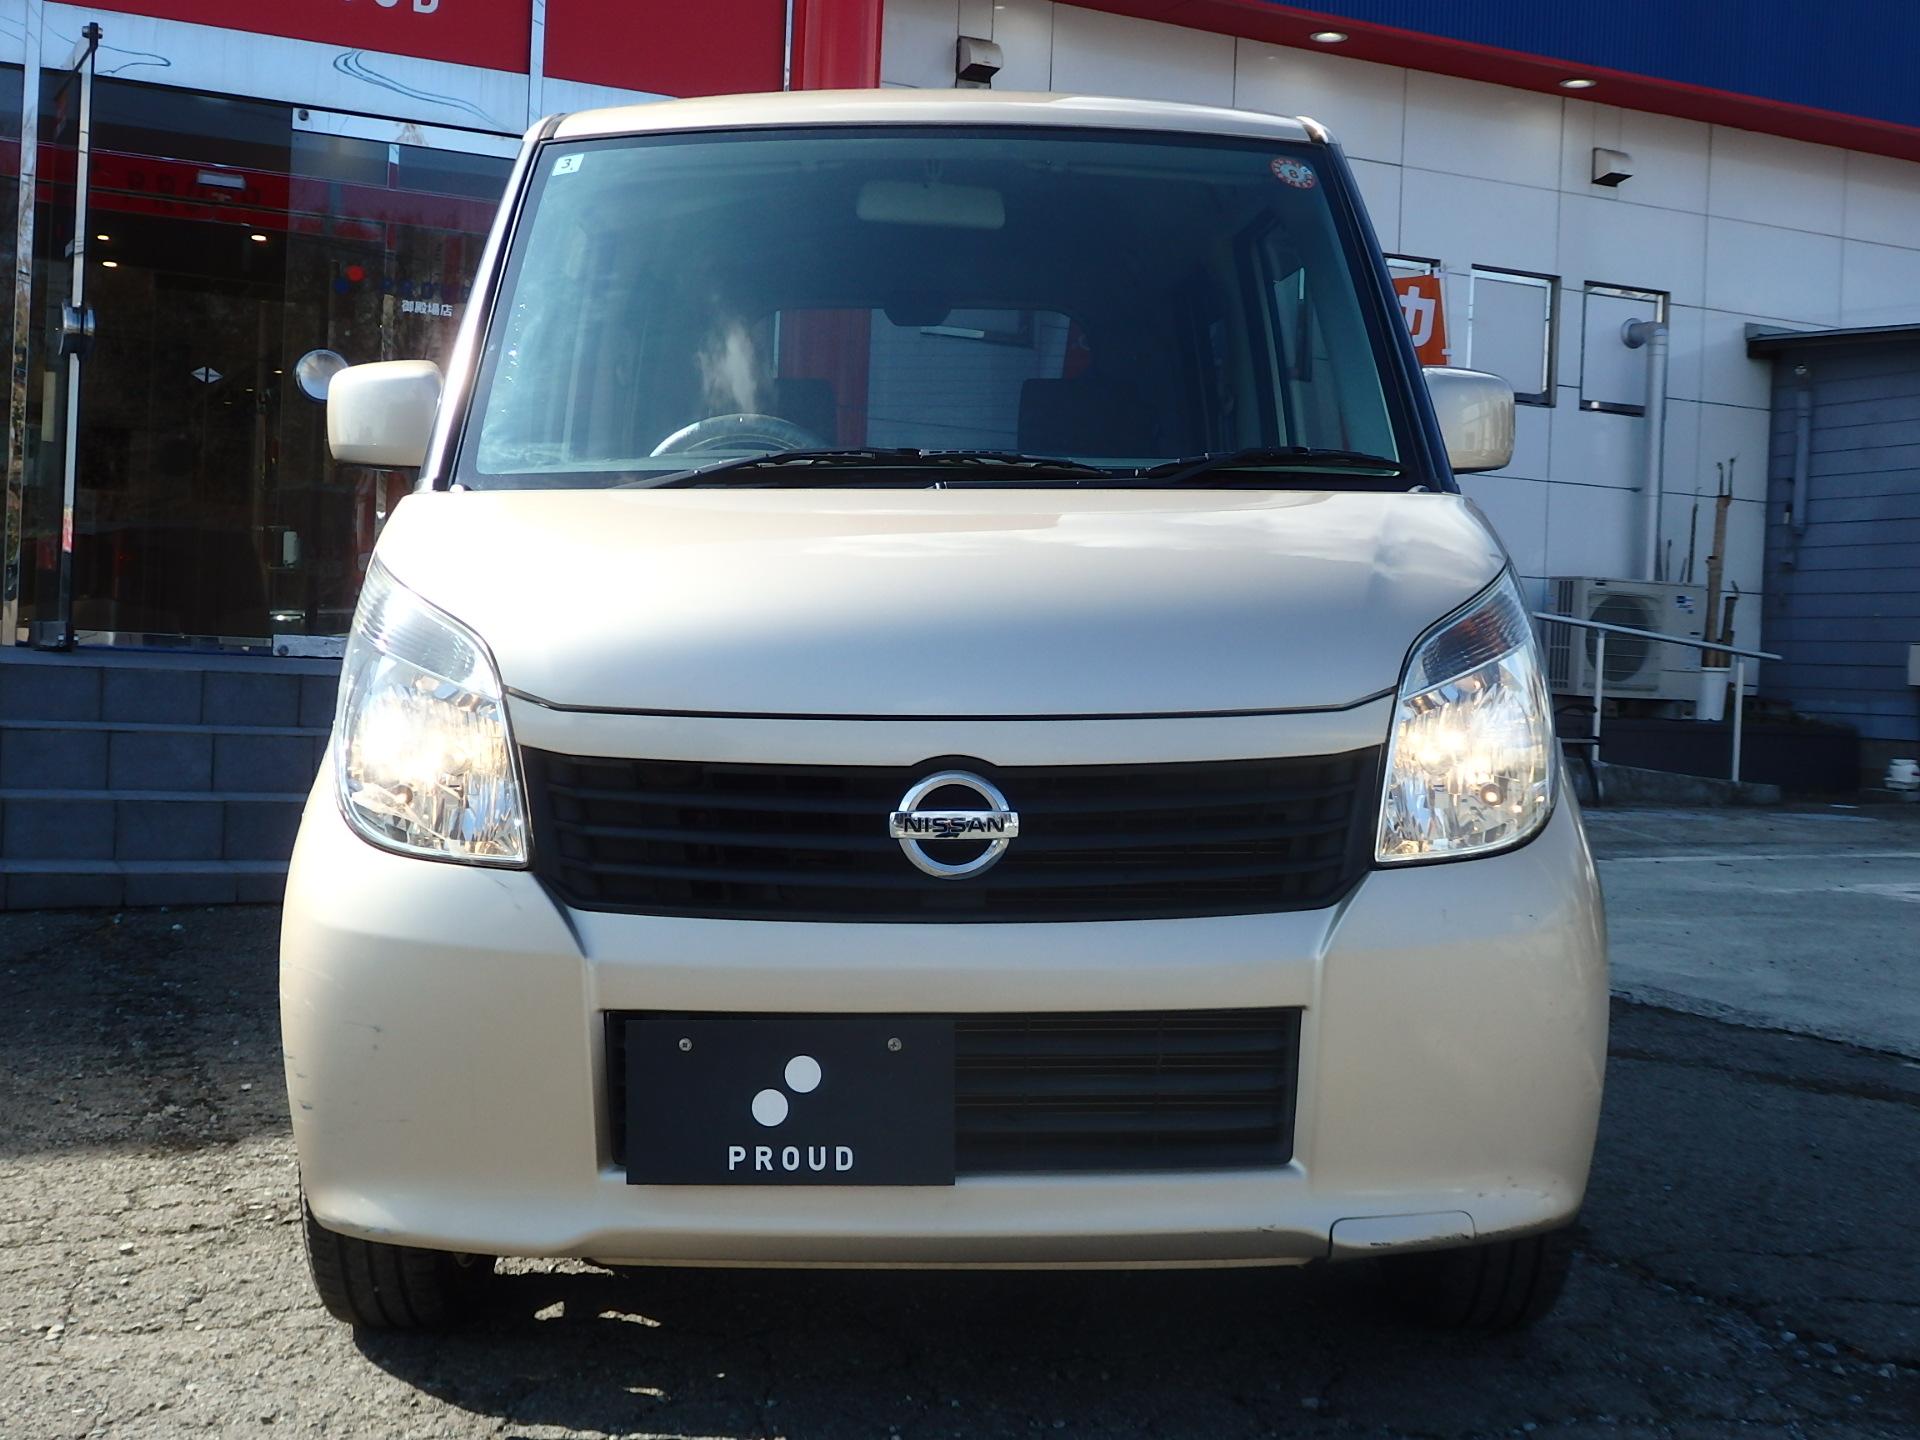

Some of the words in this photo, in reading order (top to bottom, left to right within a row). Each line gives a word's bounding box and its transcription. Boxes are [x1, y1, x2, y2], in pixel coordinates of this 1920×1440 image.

[401, 299, 454, 317] 御殿場店
[903, 817, 1005, 833] NISSAN
[728, 1145, 855, 1172] PROUD
